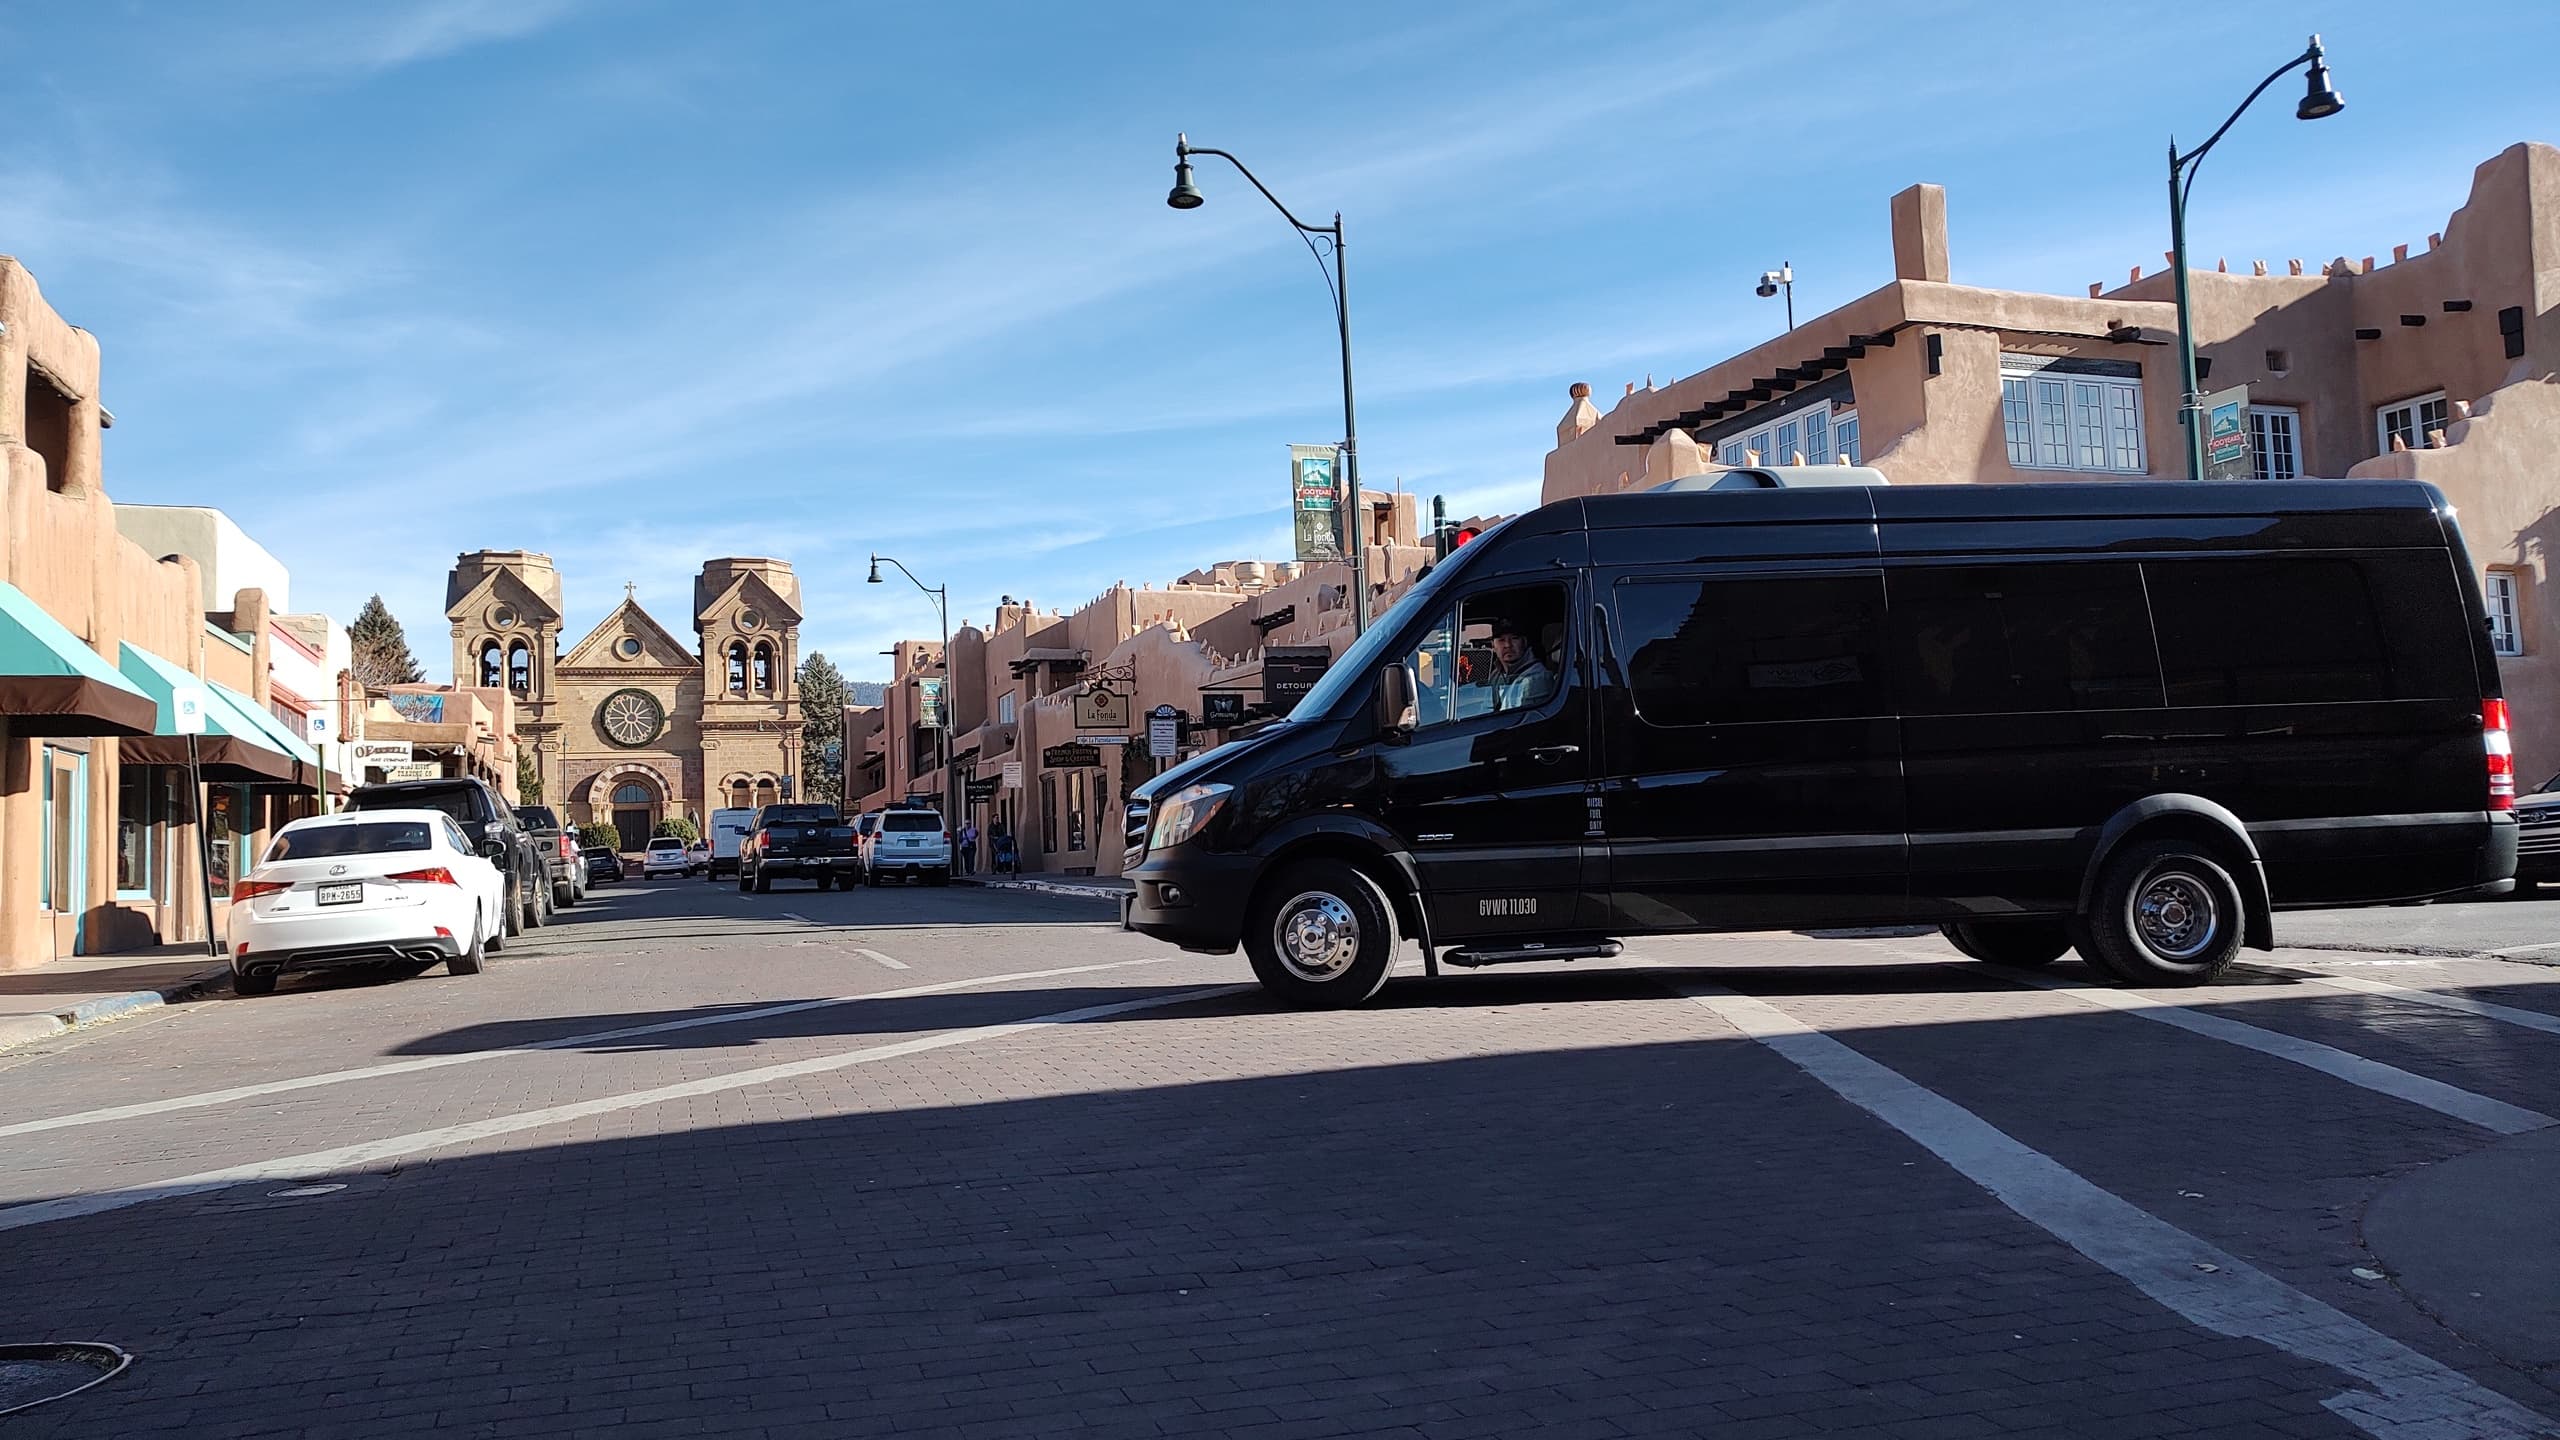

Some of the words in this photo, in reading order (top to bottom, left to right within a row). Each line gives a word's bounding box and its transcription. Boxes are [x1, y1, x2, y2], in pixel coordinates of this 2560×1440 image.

[1303, 529, 1312, 541] La
[1313, 529, 1335, 545] Fonda
[1087, 709, 1095, 719] La
[1096, 708, 1117, 721] Fonda
[1586, 797, 1604, 808] DIESEL
[1589, 809, 1601, 819] FUEL
[1589, 820, 1602, 830] ONLY
[1479, 898, 1507, 917] GVWR
